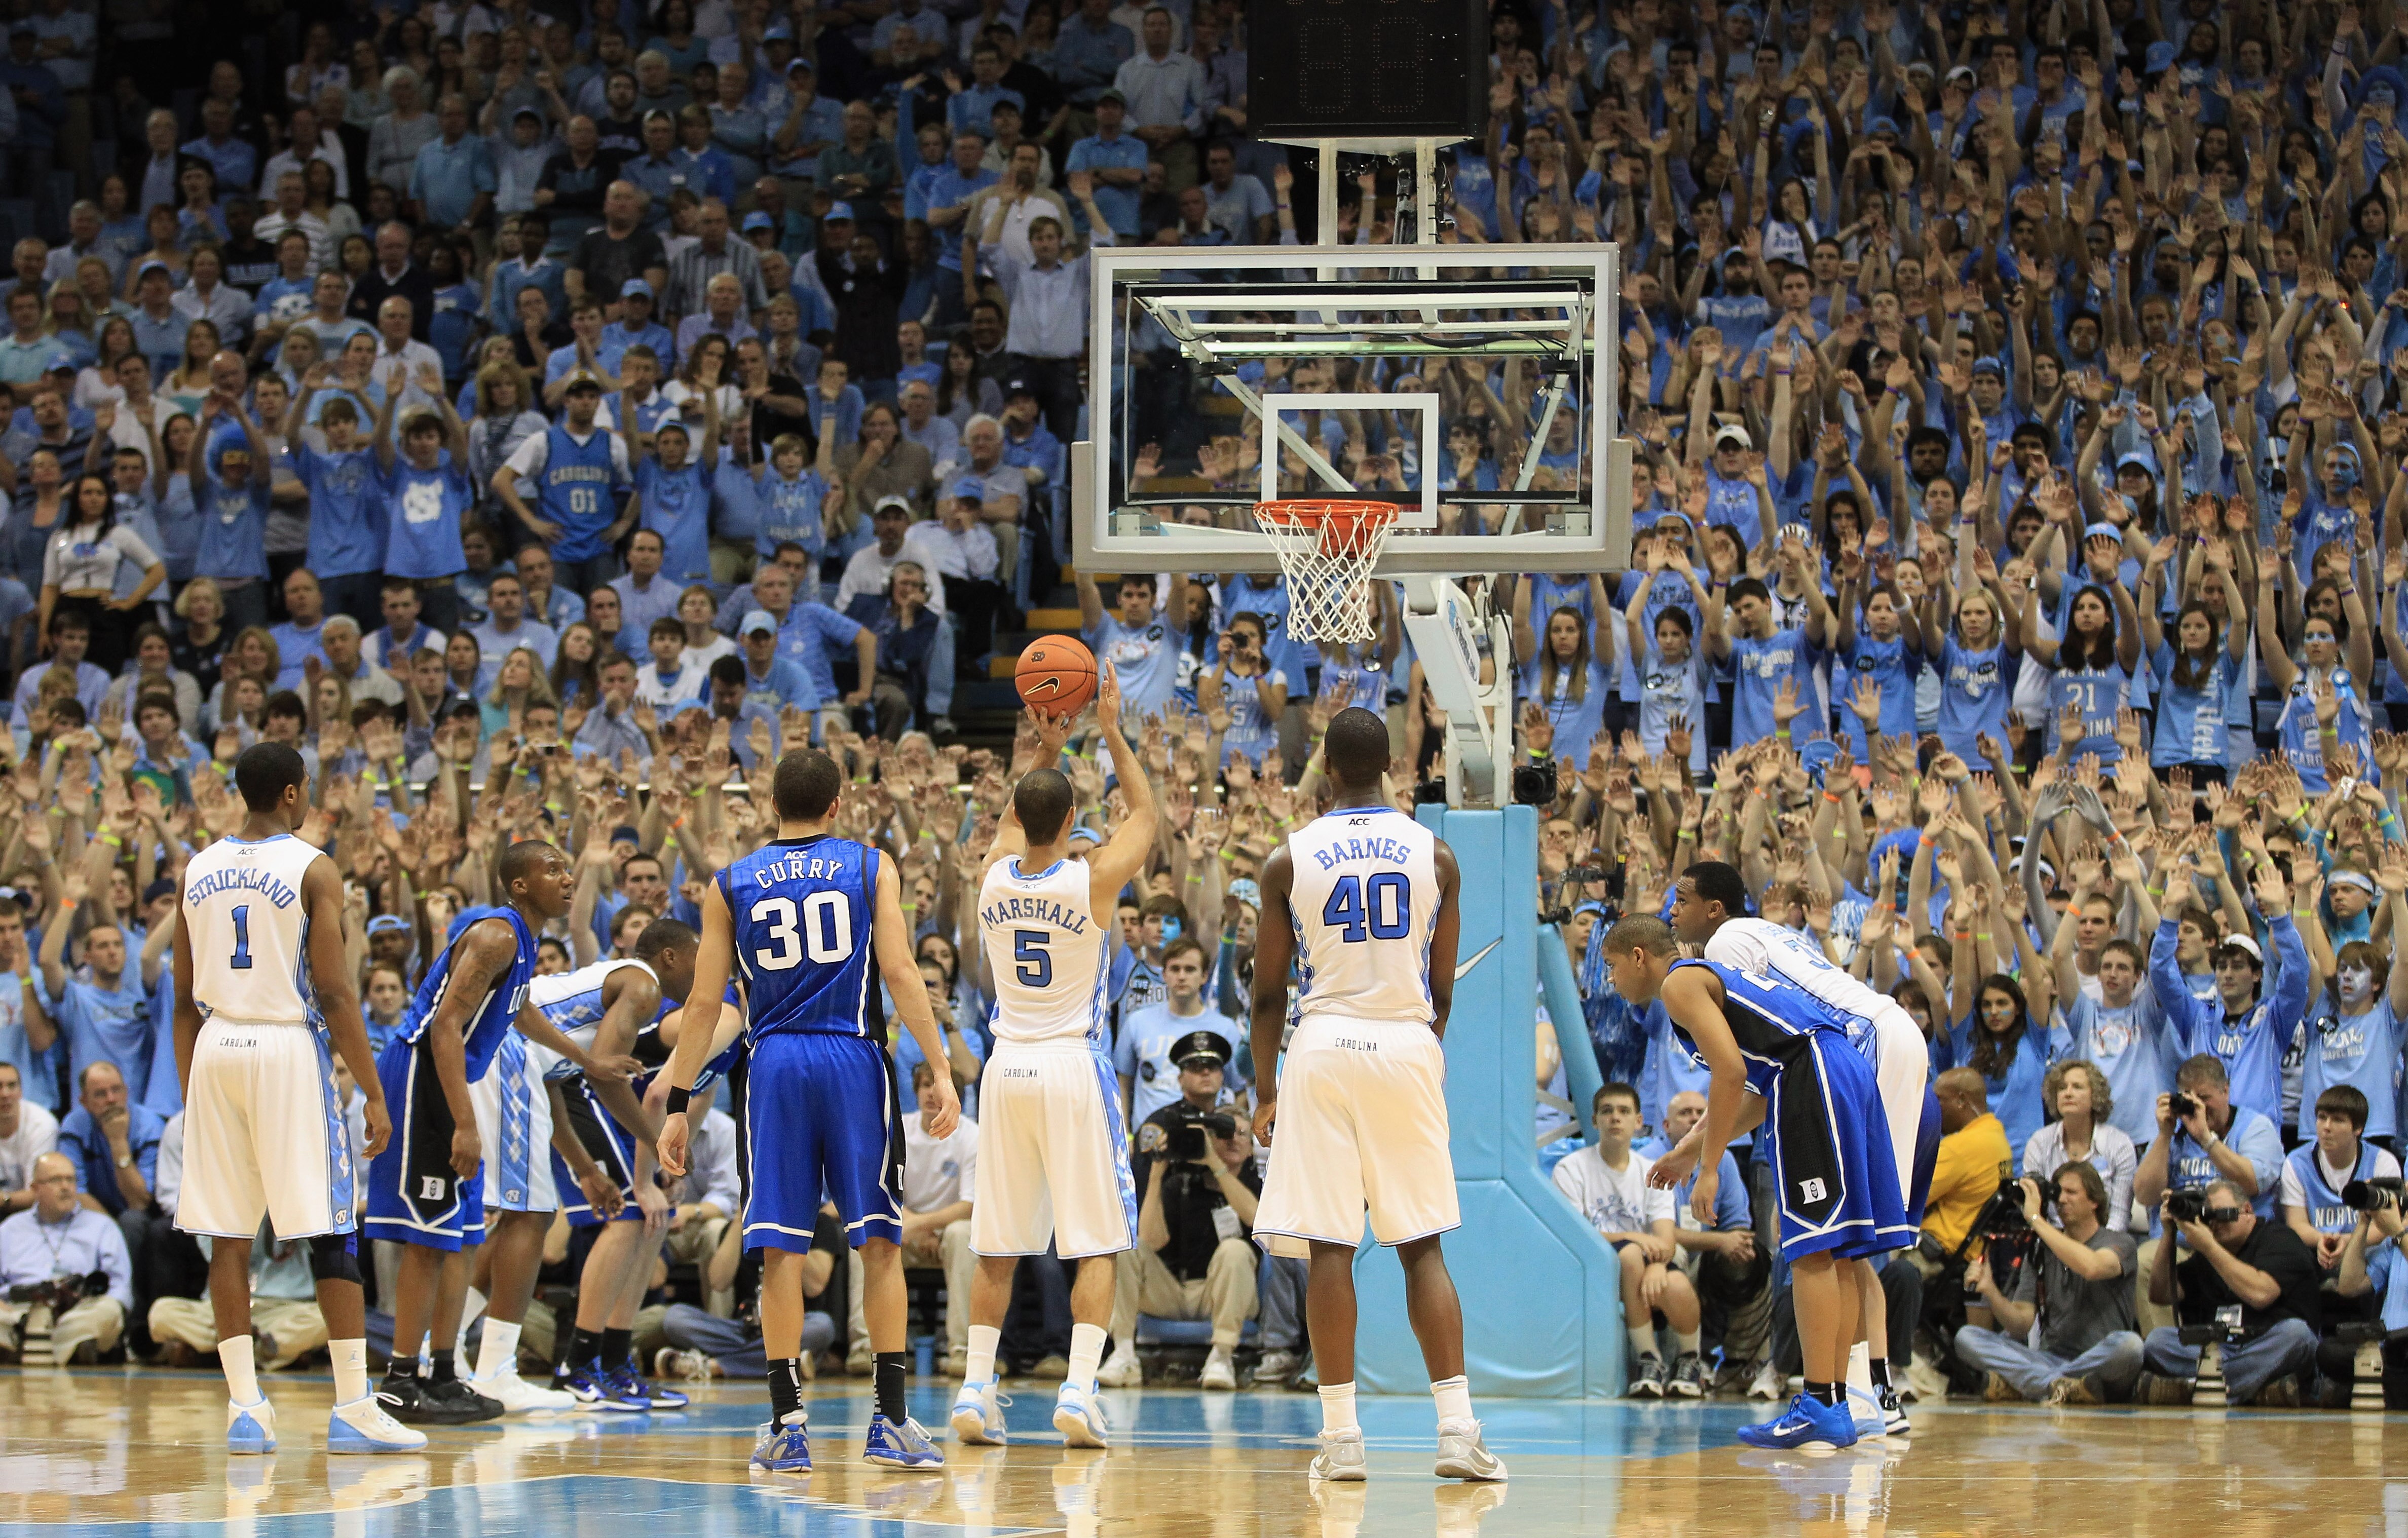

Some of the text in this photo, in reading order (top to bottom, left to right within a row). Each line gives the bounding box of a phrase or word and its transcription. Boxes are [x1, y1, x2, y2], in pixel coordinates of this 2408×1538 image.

[570, 488, 598, 514] 01
[783, 851, 808, 860] ACC
[1313, 837, 1411, 871] BARNES
[186, 868, 296, 910] STRICKLAND
[754, 858, 844, 890] CURRY
[981, 898, 1088, 936] MARSHALL
[1323, 872, 1411, 943] 40
[231, 905, 252, 969] 1
[750, 890, 853, 971] 30
[1014, 930, 1052, 988] 5
[219, 1037, 257, 1048] CAROLINA
[1335, 1037, 1377, 1052] CAROLINA
[1003, 1068, 1037, 1078] CAROLINA
